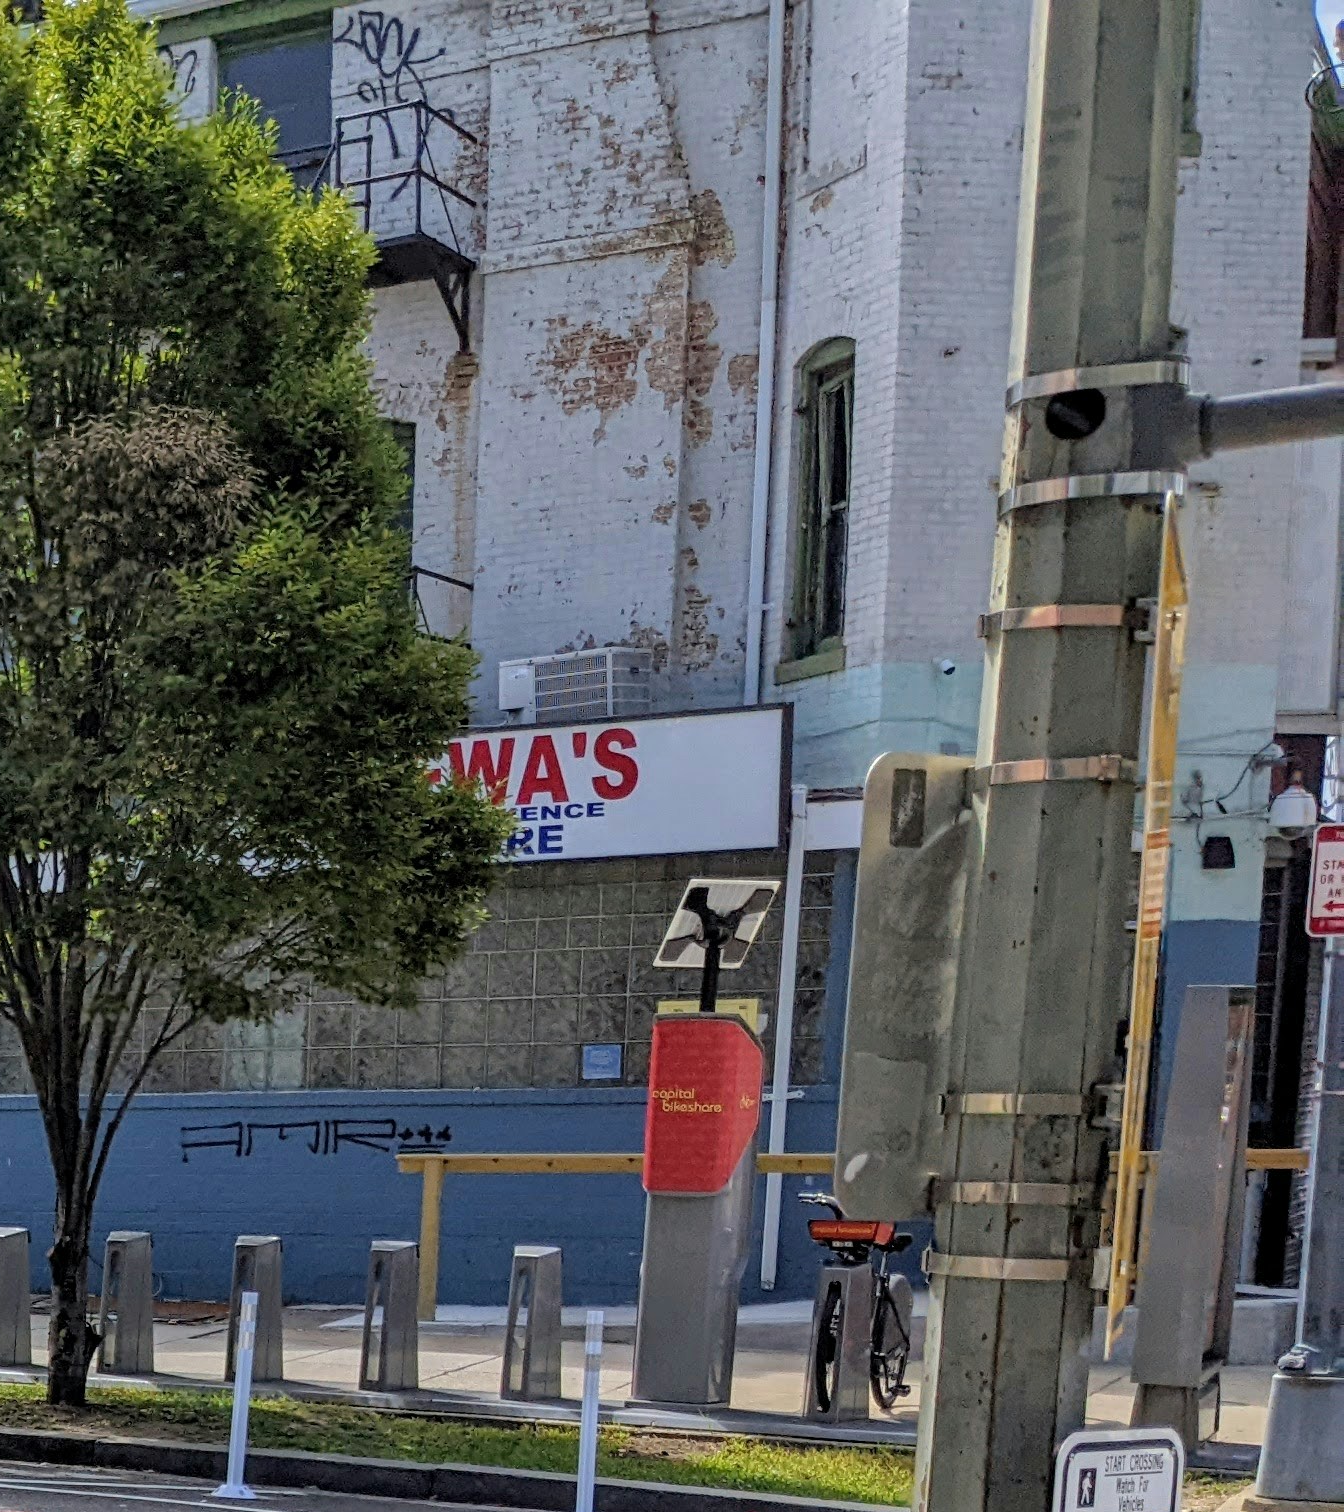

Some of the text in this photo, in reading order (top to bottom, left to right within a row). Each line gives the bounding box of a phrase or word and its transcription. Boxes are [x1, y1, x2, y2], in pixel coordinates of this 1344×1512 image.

[428, 728, 639, 805] WA'S
[652, 1087, 695, 1101] capital
[662, 1101, 723, 1113] bikeshare
[1104, 1453, 1164, 1473] START CROSSING
[1116, 1475, 1150, 1494] Watch For
[1118, 1496, 1145, 1512] Vehicles
